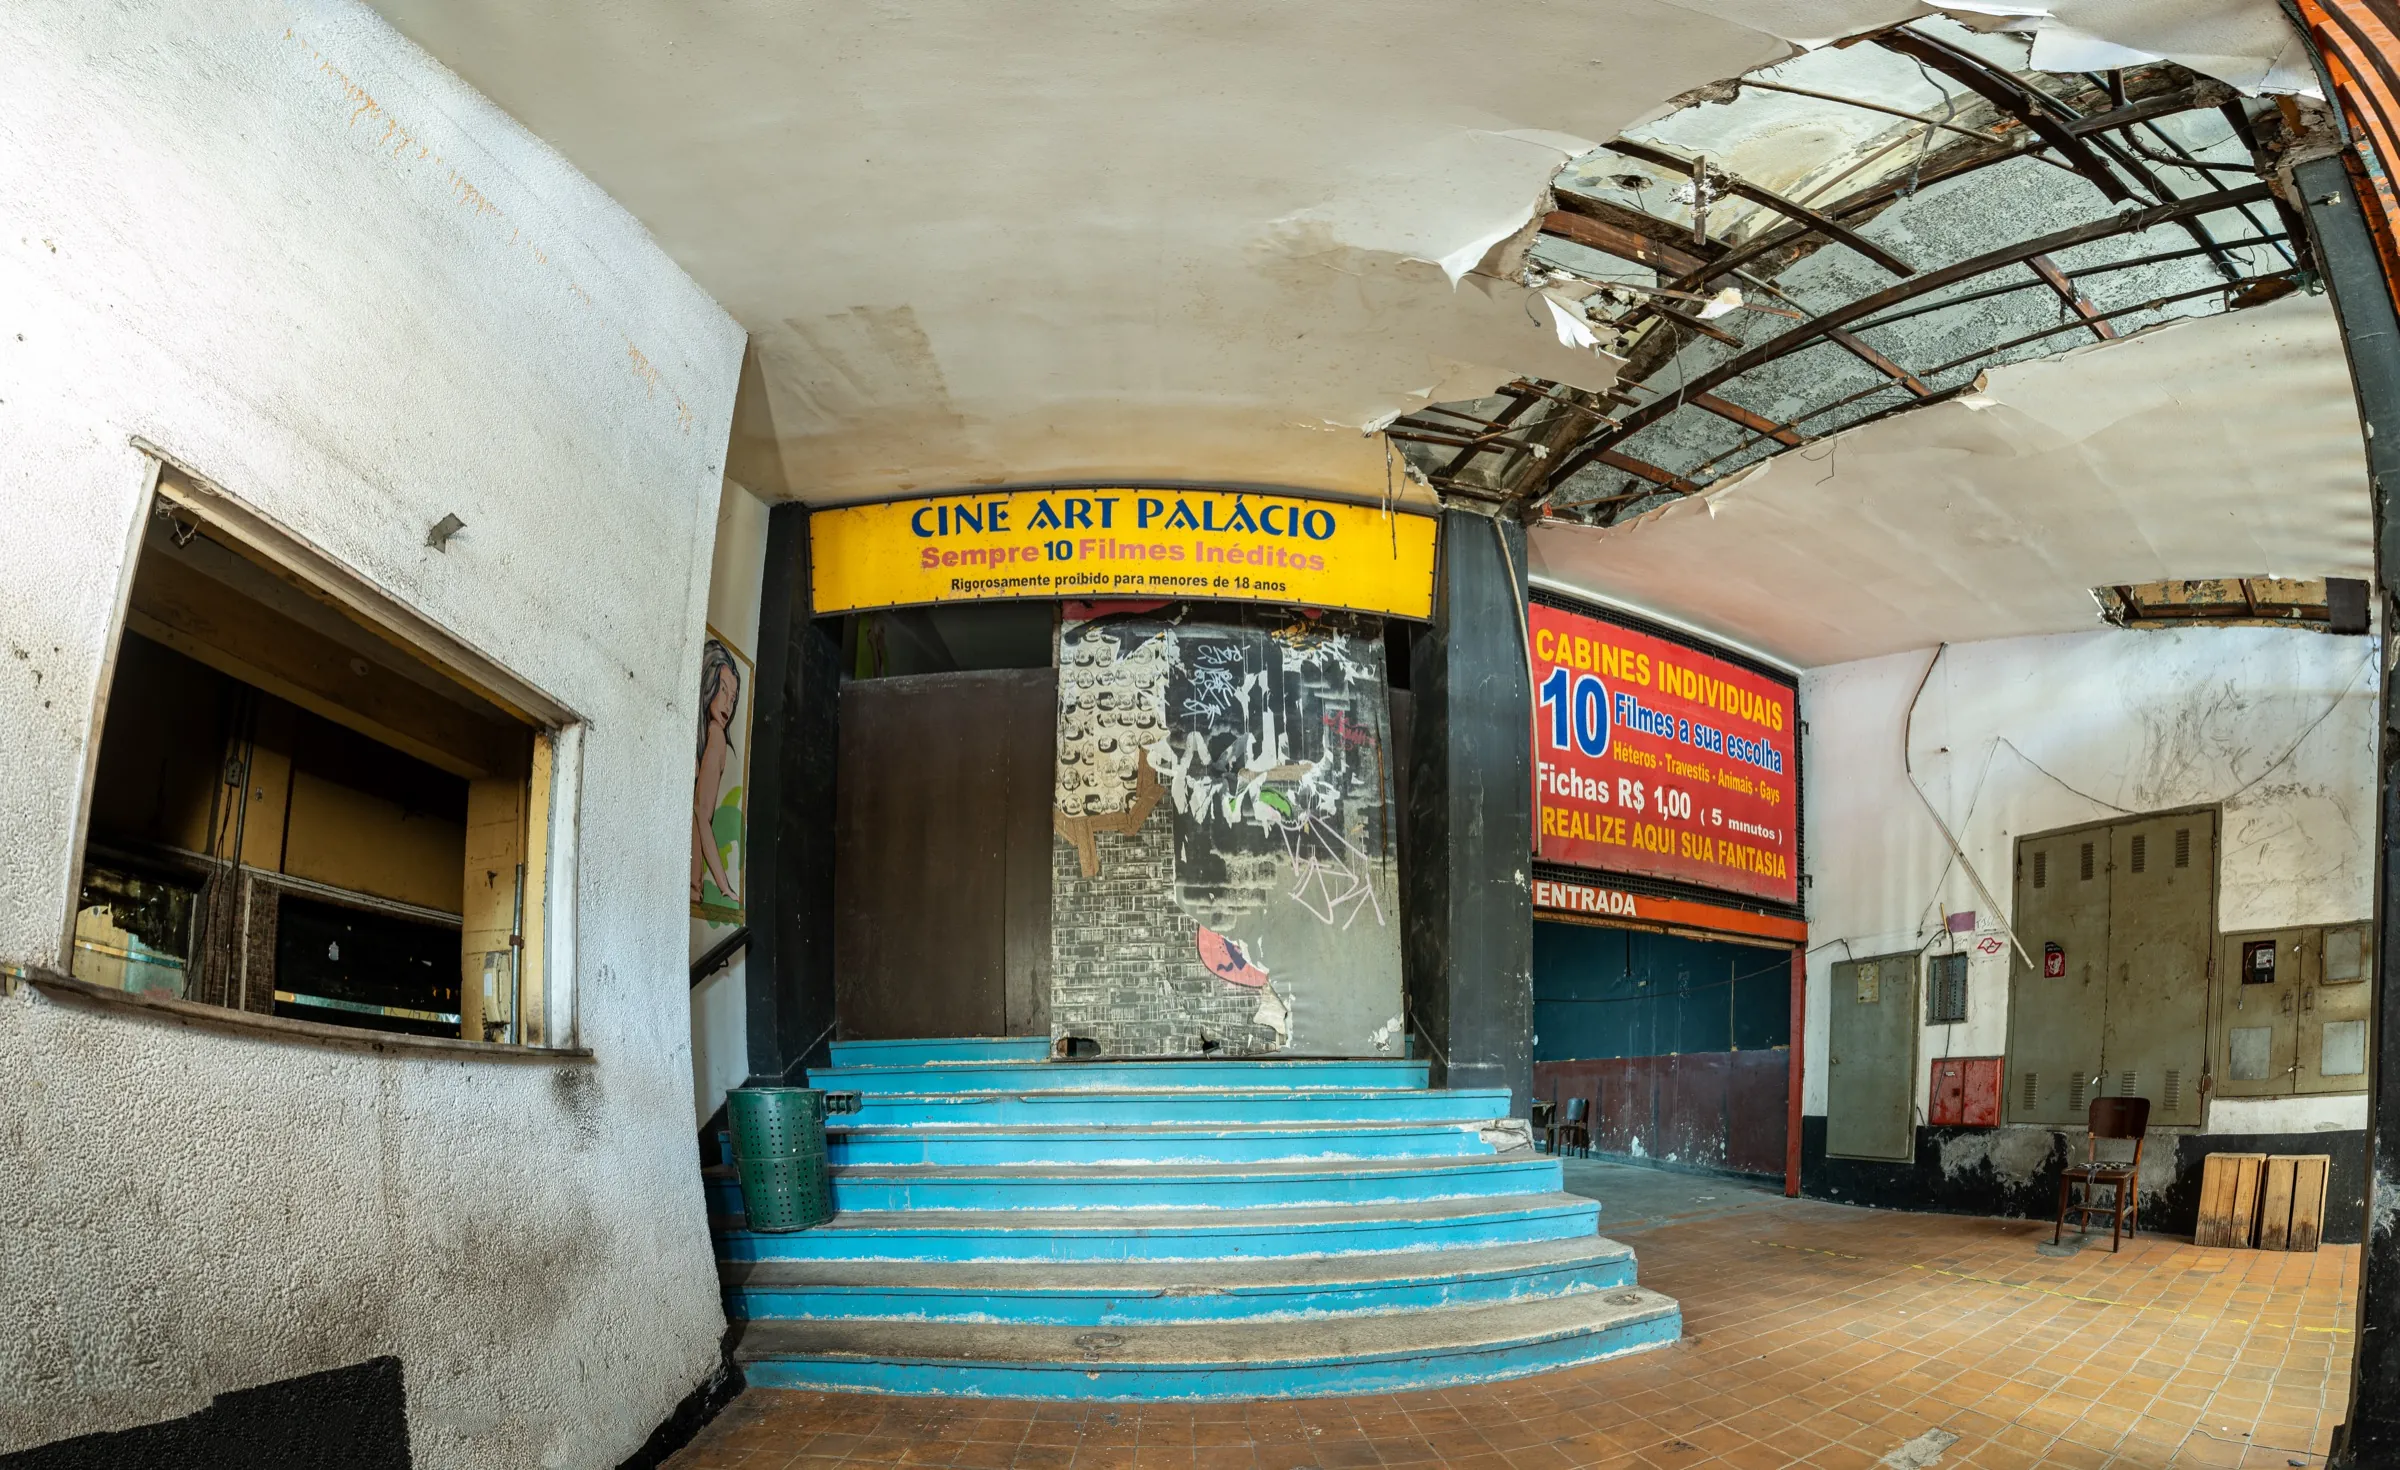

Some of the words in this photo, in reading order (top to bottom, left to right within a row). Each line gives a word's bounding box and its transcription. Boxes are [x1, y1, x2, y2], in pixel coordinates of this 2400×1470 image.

[911, 501, 1011, 538] CINE
[1027, 498, 1120, 530] ART
[1137, 494, 1336, 540] PALÁCIO
[921, 545, 1040, 569] Sempre
[1044, 540, 1073, 561] 10
[1079, 538, 1185, 562] Filmes
[1195, 541, 1325, 571] Inéditos
[951, 574, 1050, 592] Rigorosamente
[1055, 572, 1109, 588] proibido
[1114, 574, 1144, 587] para
[1149, 575, 1208, 587] menores
[1213, 576, 1229, 588] de
[1234, 576, 1250, 589] 18
[1254, 580, 1286, 592] anos
[1536, 628, 1651, 687] CABINES
[1658, 660, 1783, 732] INDIVIDUAIS
[1540, 666, 1611, 758] 10
[1614, 691, 1674, 739] Filmes
[1679, 718, 1690, 744] a
[1694, 722, 1723, 755] sua
[1727, 733, 1783, 774] escolha
[1538, 762, 1609, 803] Fichas
[1618, 777, 1645, 814] R$
[1654, 785, 1691, 821] 1,00
[1613, 740, 1657, 769] Héteros
[1665, 753, 1710, 783] Travestis
[1718, 768, 1753, 796] Animais
[1760, 780, 1780, 806] Gays
[1542, 805, 1627, 846] REALIZE
[1632, 821, 1676, 855] AQUI
[1681, 831, 1714, 863] SUA
[1718, 839, 1787, 879] FANTASIA
[1537, 881, 1637, 917] ENTRADA
